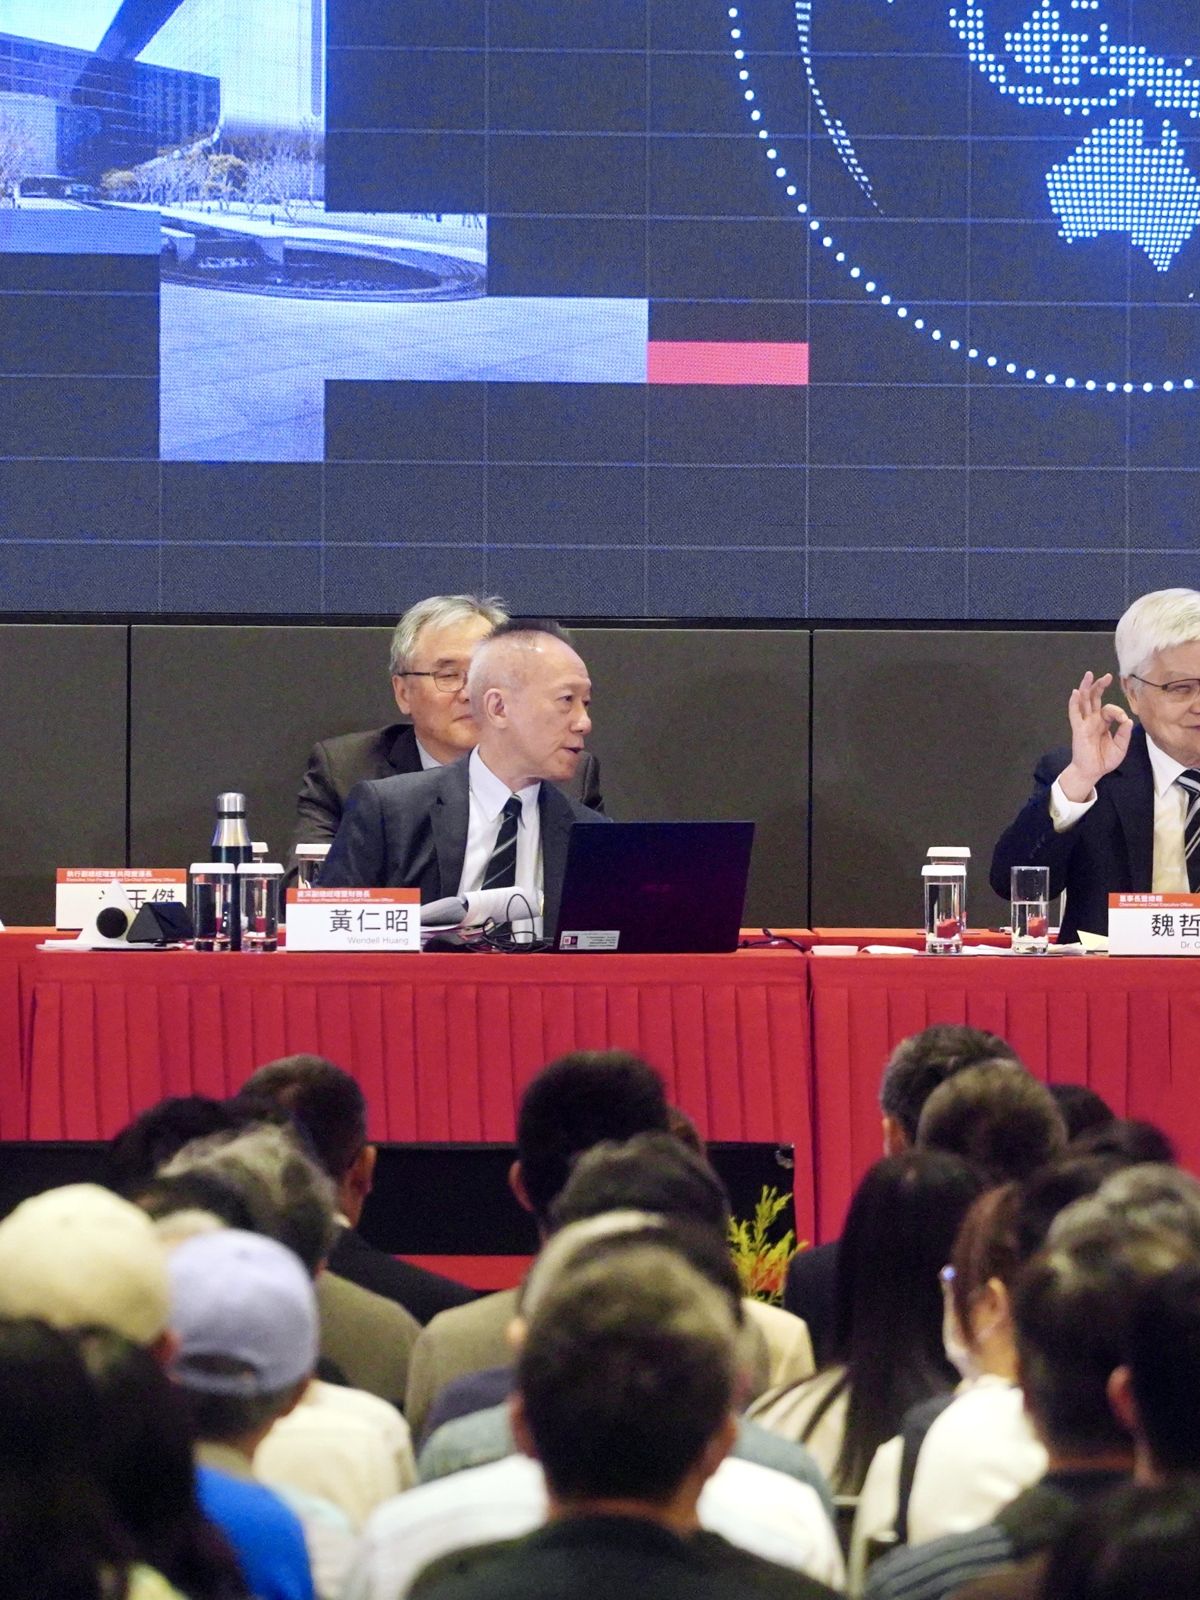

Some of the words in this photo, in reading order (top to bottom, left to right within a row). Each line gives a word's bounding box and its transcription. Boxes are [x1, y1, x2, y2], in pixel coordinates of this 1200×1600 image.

[329, 909, 408, 932] 黃仁昭
[348, 936, 380, 944] Wendell
[382, 936, 408, 946] Huang
[1180, 941, 1191, 949] Dr.
